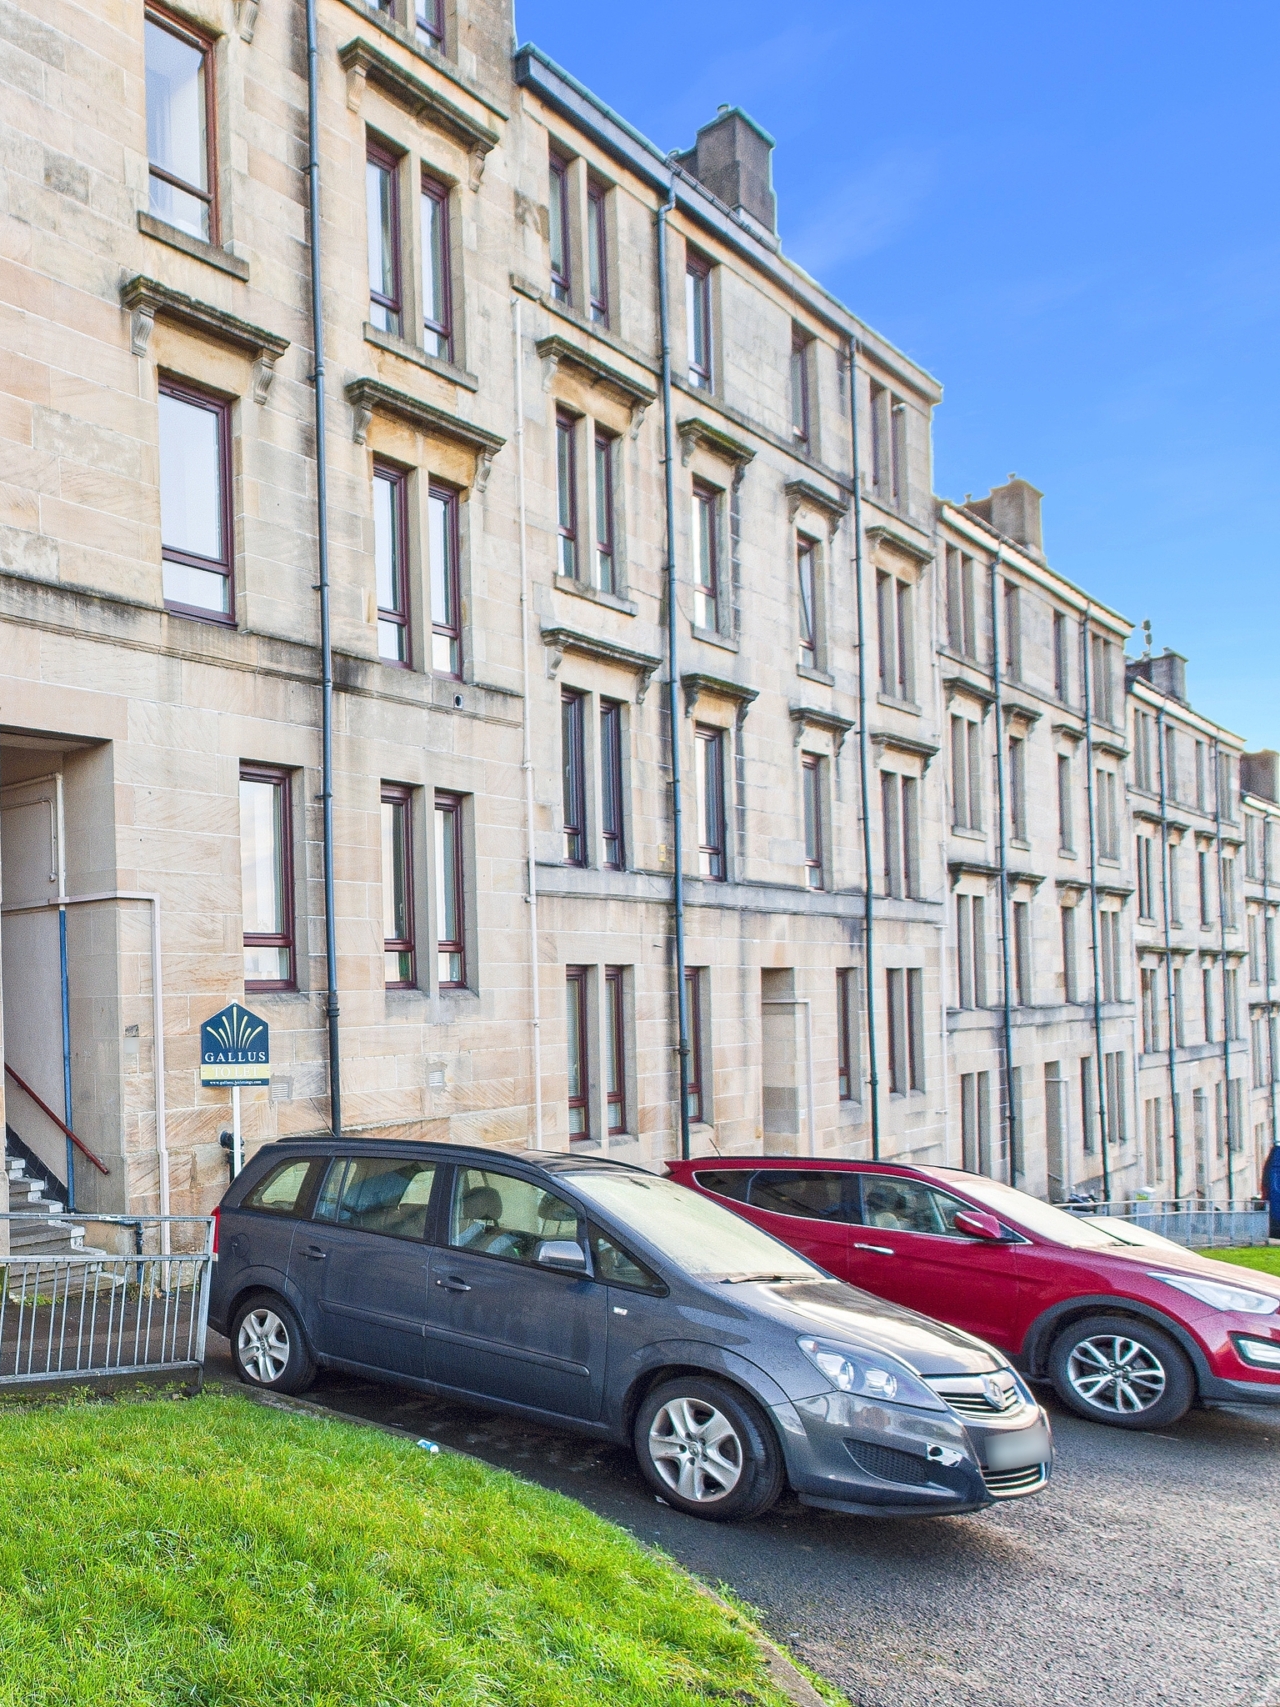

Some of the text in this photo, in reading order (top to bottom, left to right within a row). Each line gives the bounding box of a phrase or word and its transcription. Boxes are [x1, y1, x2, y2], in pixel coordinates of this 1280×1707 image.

[204, 1051, 266, 1063] GALLUS
[212, 1066, 260, 1078] TO LET
